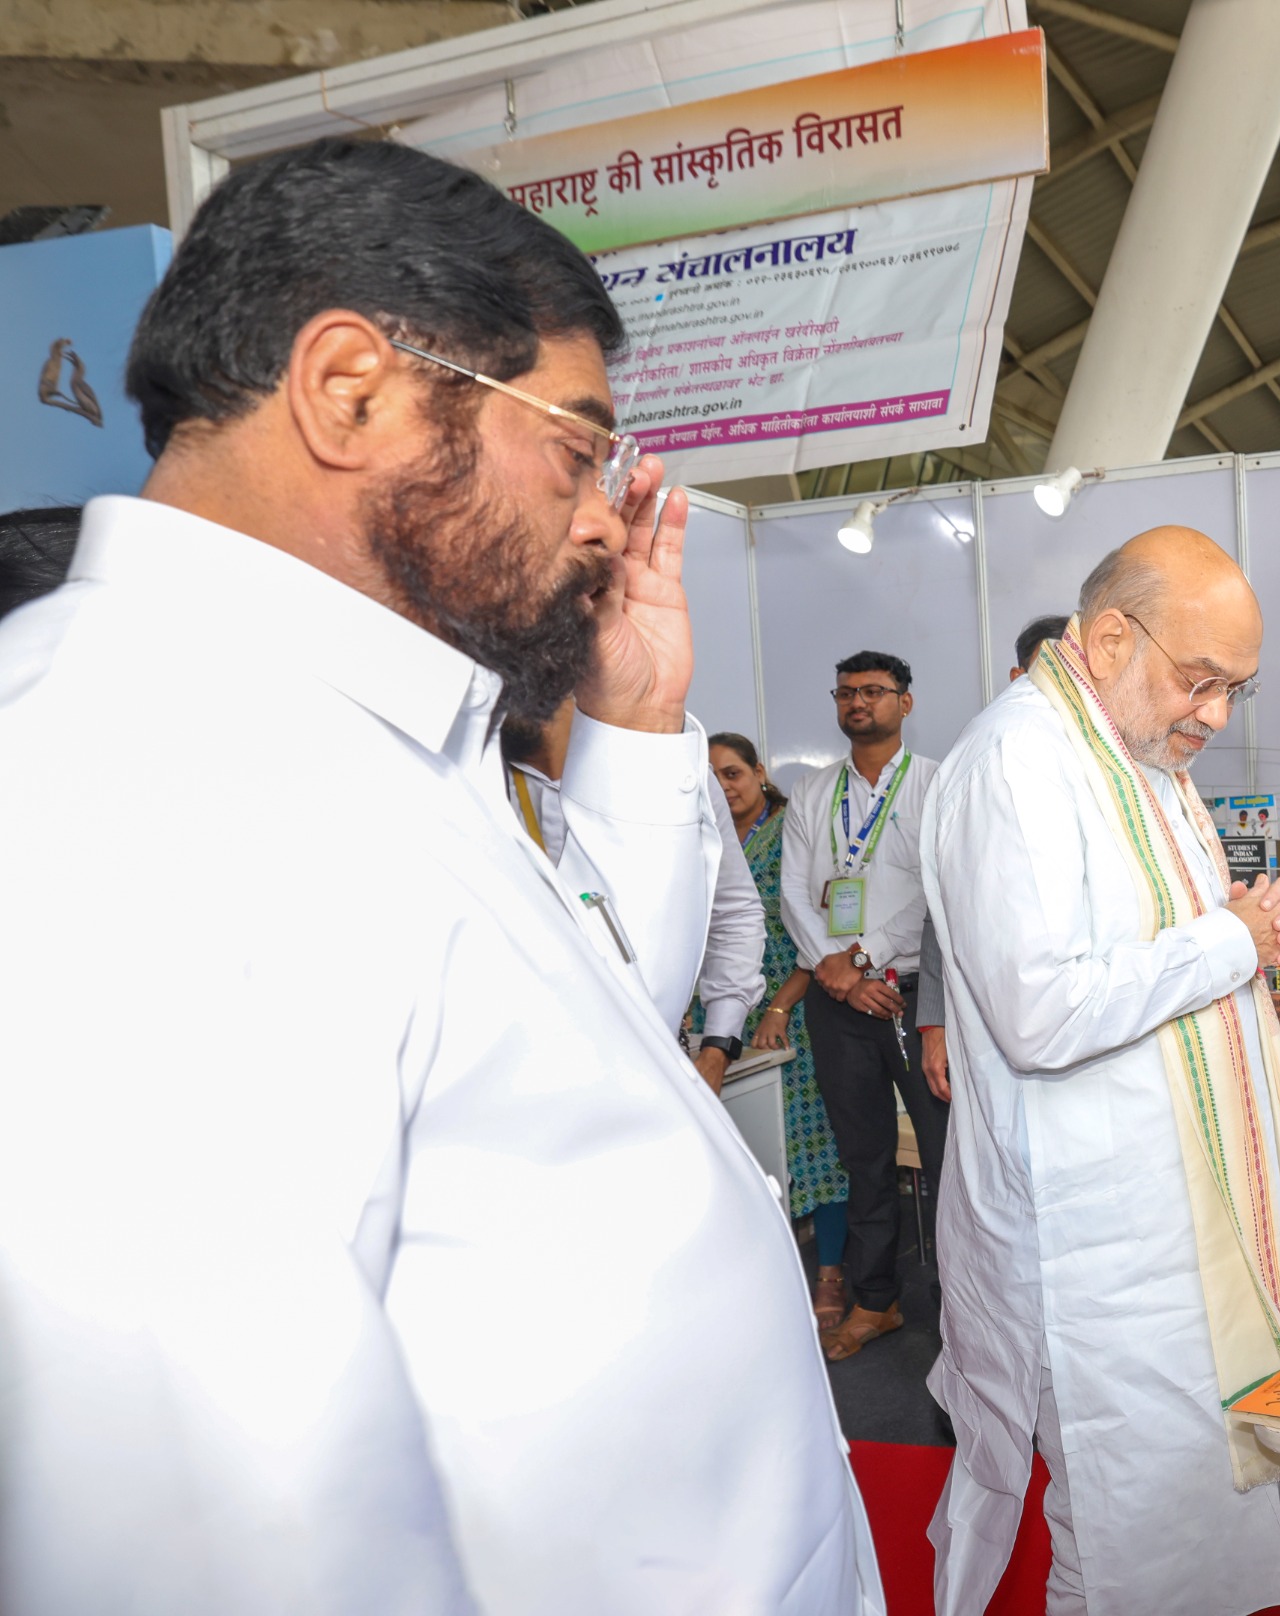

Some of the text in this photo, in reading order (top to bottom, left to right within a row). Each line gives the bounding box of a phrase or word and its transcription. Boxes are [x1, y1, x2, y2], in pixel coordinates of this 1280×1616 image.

[506, 105, 904, 217] महाराष्ट्र की सांस्कृतिक विरासत
[656, 229, 858, 283] संचालनालय
[689, 354, 732, 377] शासकीय
[737, 349, 779, 371] अधिकृत
[782, 343, 820, 363] विक्रेता
[728, 418, 757, 437] अधिक
[761, 413, 819, 434] माहितीकरिता
[821, 403, 877, 425] कार्यालयाशी
[879, 399, 905, 418] संपर्क
[908, 397, 944, 414] साधावा
[1228, 844, 1250, 852] STUDIES
